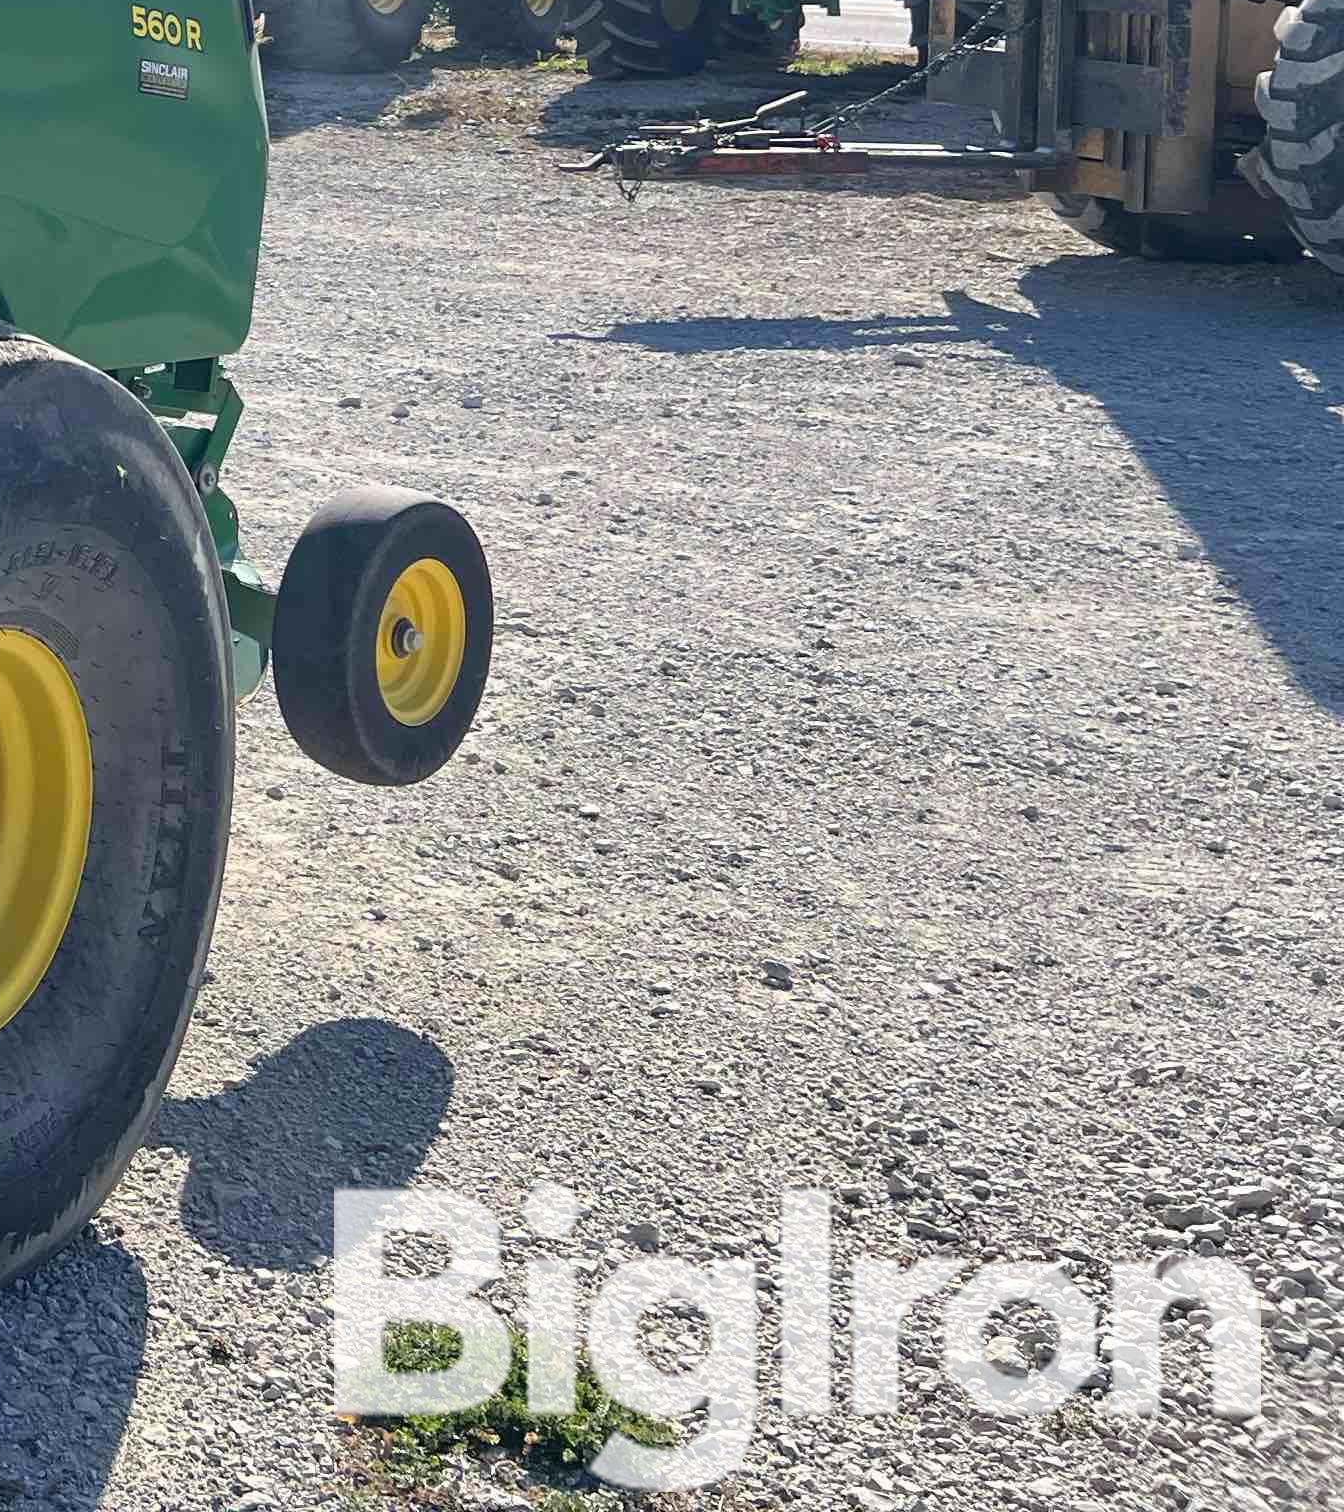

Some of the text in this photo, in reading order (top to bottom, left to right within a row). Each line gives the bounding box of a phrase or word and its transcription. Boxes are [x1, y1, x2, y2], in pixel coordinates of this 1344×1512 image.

[131, 4, 203, 51] 560 R
[141, 60, 188, 81] SINCLAIR
